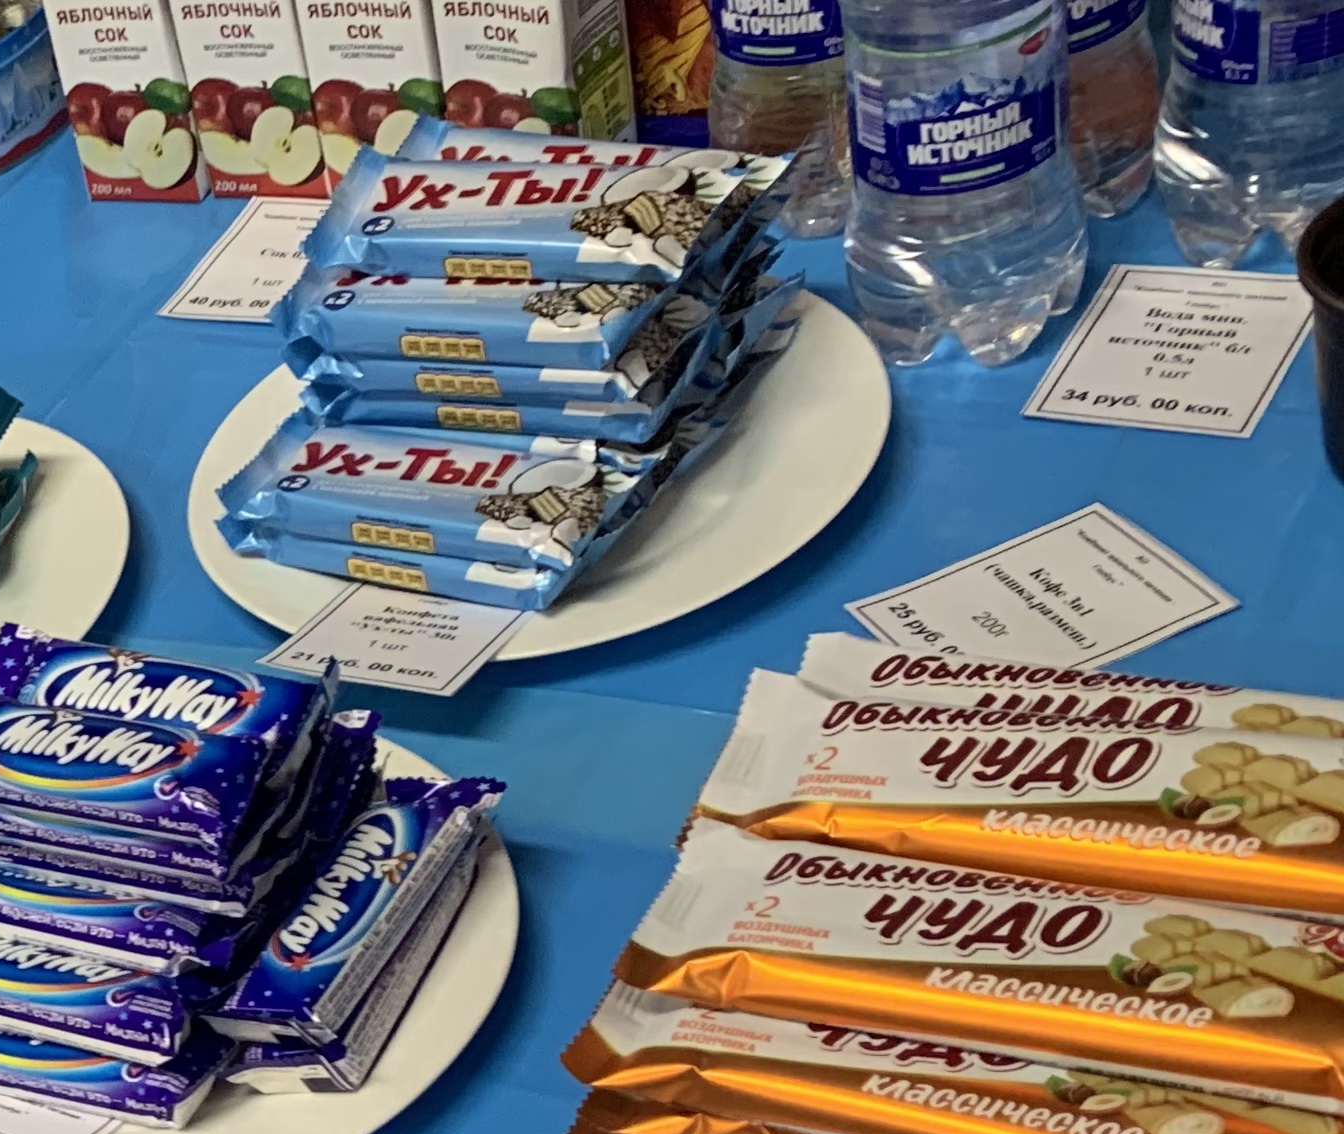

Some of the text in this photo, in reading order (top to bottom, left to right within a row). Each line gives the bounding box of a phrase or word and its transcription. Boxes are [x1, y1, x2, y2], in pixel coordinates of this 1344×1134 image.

[57, 4, 153, 25] ЯБЛОЧНЫЙ
[181, 1, 281, 20] ЯБЛОЧНЫЙ
[308, 1, 412, 19] ЯБЛОЧНЫЙ
[444, 2, 550, 25] ЯБЛОЧНЫЙ
[220, 24, 254, 39] СОК
[347, 24, 384, 39] СОК
[720, 9, 825, 36] ИСТОЧНИК
[95, 27, 129, 43] СОК
[483, 26, 518, 44] СОК
[919, 101, 1021, 144] ГОРНЫЙ
[906, 118, 1033, 166] ИСТОЧНИК
[91, 183, 113, 195] 200
[214, 180, 258, 192] 200 мл
[372, 168, 605, 212] Ух-Ты!
[251, 277, 287, 288] 1 шт
[188, 296, 271, 309] 40 руб. 00
[1145, 306, 1196, 321] Вода
[1143, 320, 1238, 339] "Горный
[1143, 366, 1192, 381] 1 шт
[1061, 388, 1233, 418] 34 руб. 00 коп.
[290, 441, 517, 489] Ух-Ты!
[1027, 566, 1069, 598] Кофе
[362, 614, 460, 631] вафельная
[381, 605, 460, 622] Конфета
[886, 602, 942, 647] 25 руб.
[970, 610, 1012, 639] 200г
[367, 639, 410, 652] 1 шт
[291, 651, 439, 680] 21 рб. 00 коп.
[919, 736, 1155, 793] ЧУДО
[981, 808, 1263, 859] классическое
[733, 920, 832, 939] ВОЗДУШНЫХ
[863, 893, 1106, 954] ЧУДО
[727, 932, 815, 951] БАТОНЧИКА
[925, 966, 1214, 1028] классическое
[676, 1018, 773, 1043] ВОЗДУШНЫХ
[671, 1031, 757, 1053] БАТОНЧИКА
